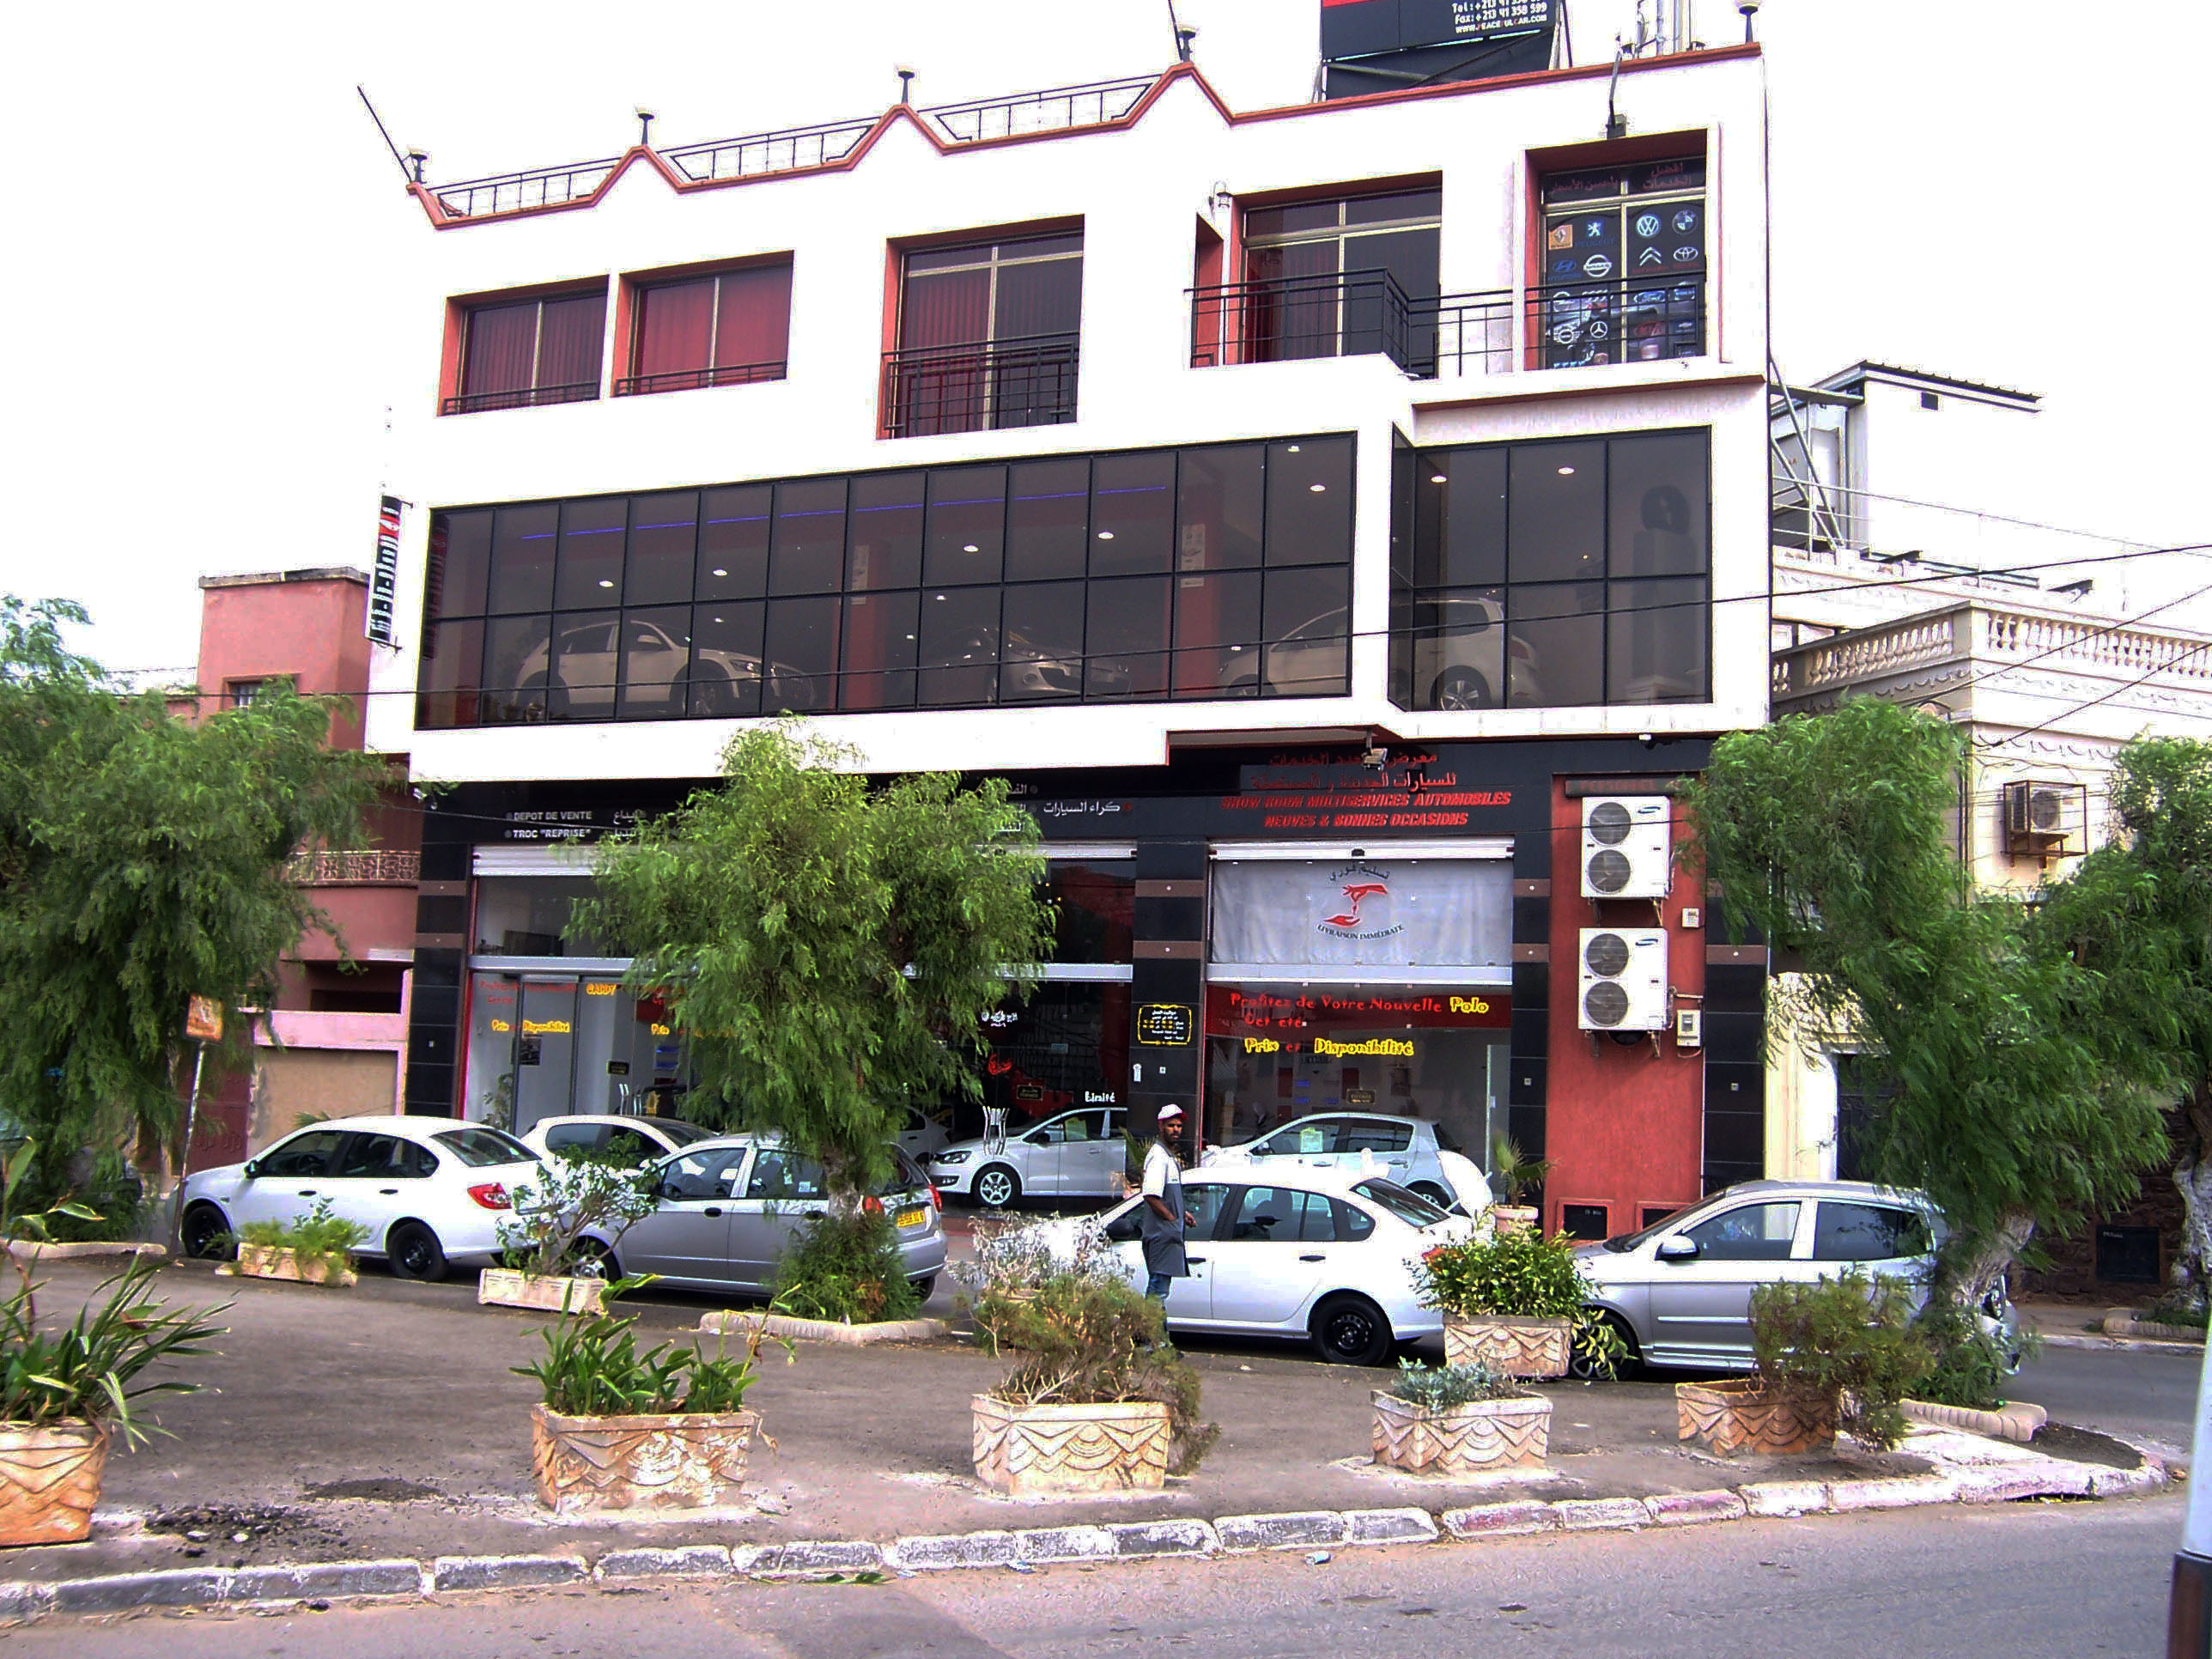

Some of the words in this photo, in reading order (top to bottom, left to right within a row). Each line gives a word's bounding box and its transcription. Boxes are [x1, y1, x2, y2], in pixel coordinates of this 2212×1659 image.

[1090, 800, 1121, 816] كراء
[1219, 795, 1261, 810] SHOW
[1264, 794, 1304, 809] ROOM
[1305, 793, 1411, 808] MULTISERVICES
[1413, 791, 1512, 807] AUTOMOBILES
[514, 811, 544, 821] DEPOT
[545, 811, 558, 821] DE
[560, 811, 592, 821] VENTE
[1043, 801, 1087, 817] السيارات
[1264, 814, 1316, 828] NEUVES
[1319, 814, 1331, 827] &
[1333, 813, 1389, 828] BONNES
[1389, 812, 1469, 827] OCCASIONS
[513, 829, 538, 839] TROC
[540, 828, 592, 838] "REPRISE"
[1317, 924, 1358, 939] LIVRAISON
[1230, 993, 1291, 1007] Profitez
[1296, 994, 1316, 1008] de
[1321, 994, 1366, 1011] Votre
[1370, 996, 1443, 1012] Nouvelle
[1449, 996, 1490, 1014] Polo
[1244, 1036, 1279, 1054] Prix
[1313, 1036, 1414, 1058] Disponibilité
